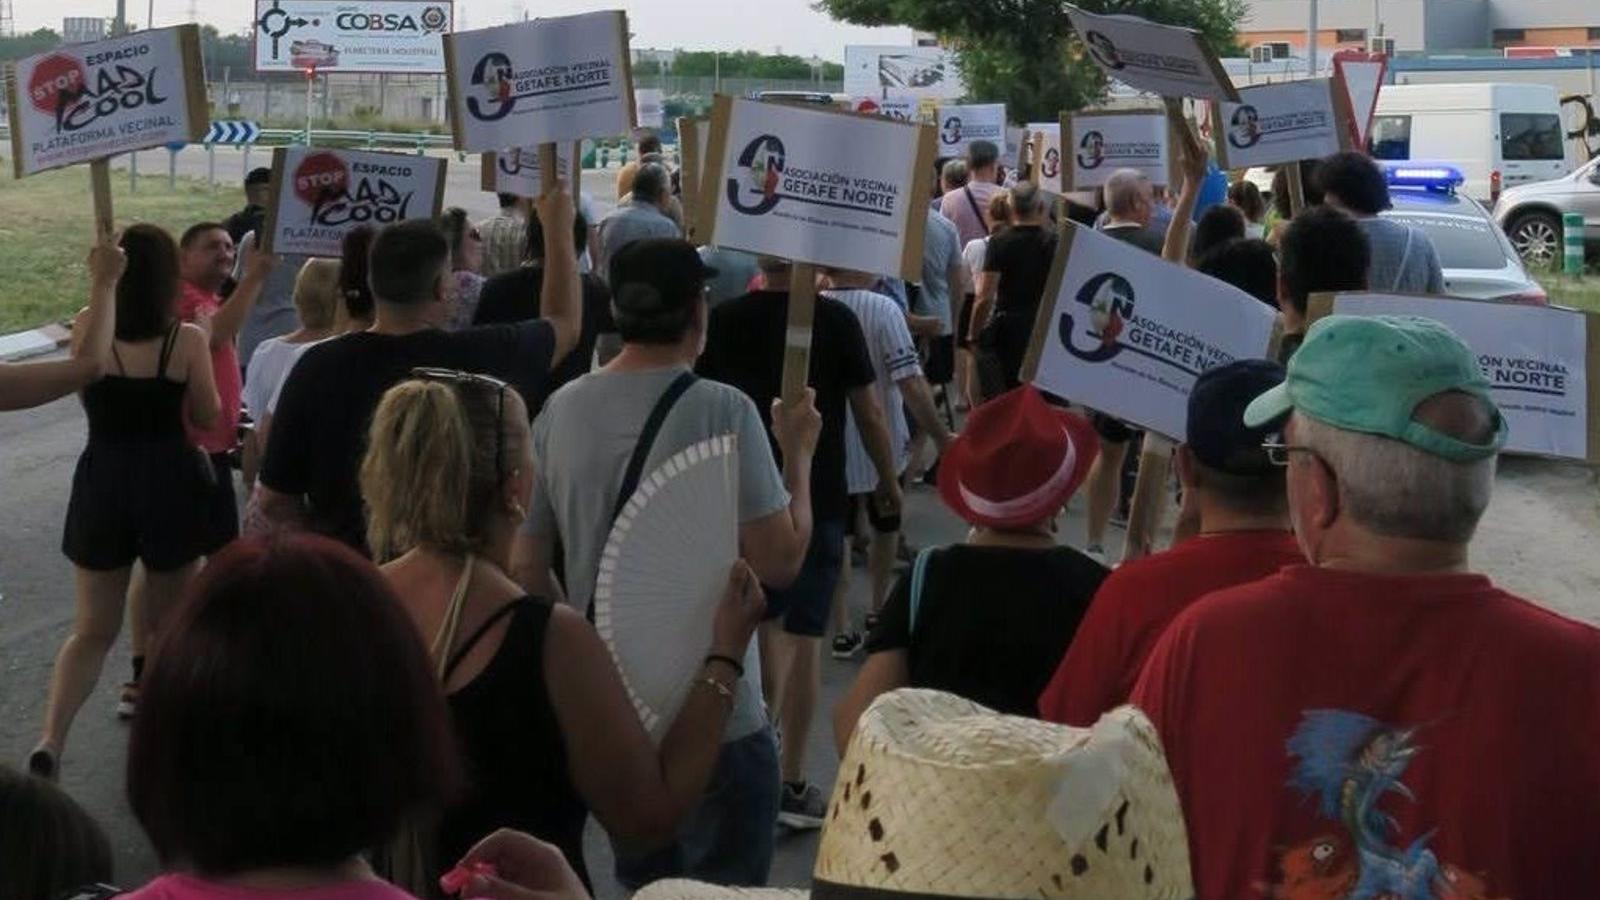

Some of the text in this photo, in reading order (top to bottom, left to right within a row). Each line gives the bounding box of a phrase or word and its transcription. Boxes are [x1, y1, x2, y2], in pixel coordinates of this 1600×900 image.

[336, 13, 418, 31] COBSA
[86, 44, 149, 66] ESPACIO
[32, 69, 80, 99] STOP
[515, 69, 609, 92] GETAFE NORTE
[55, 65, 145, 132] MAD
[63, 67, 168, 131] COOL
[32, 128, 116, 154] PLATAFORMA
[118, 115, 175, 133] VECINAL
[298, 171, 344, 191] STOP
[353, 162, 412, 177] ESPACIO
[784, 166, 899, 195] ASOCIACIÓN VECINAL
[311, 177, 400, 225] MAD
[784, 178, 896, 210] GETAFE NORTE
[283, 227, 344, 241] PLATAFOR
[1129, 329, 1191, 363] GETAFE
[1131, 316, 1237, 361] ASOCIACIÓN VECI
[1496, 369, 1565, 389] NORTE
[1507, 358, 1569, 375] VECINAL
